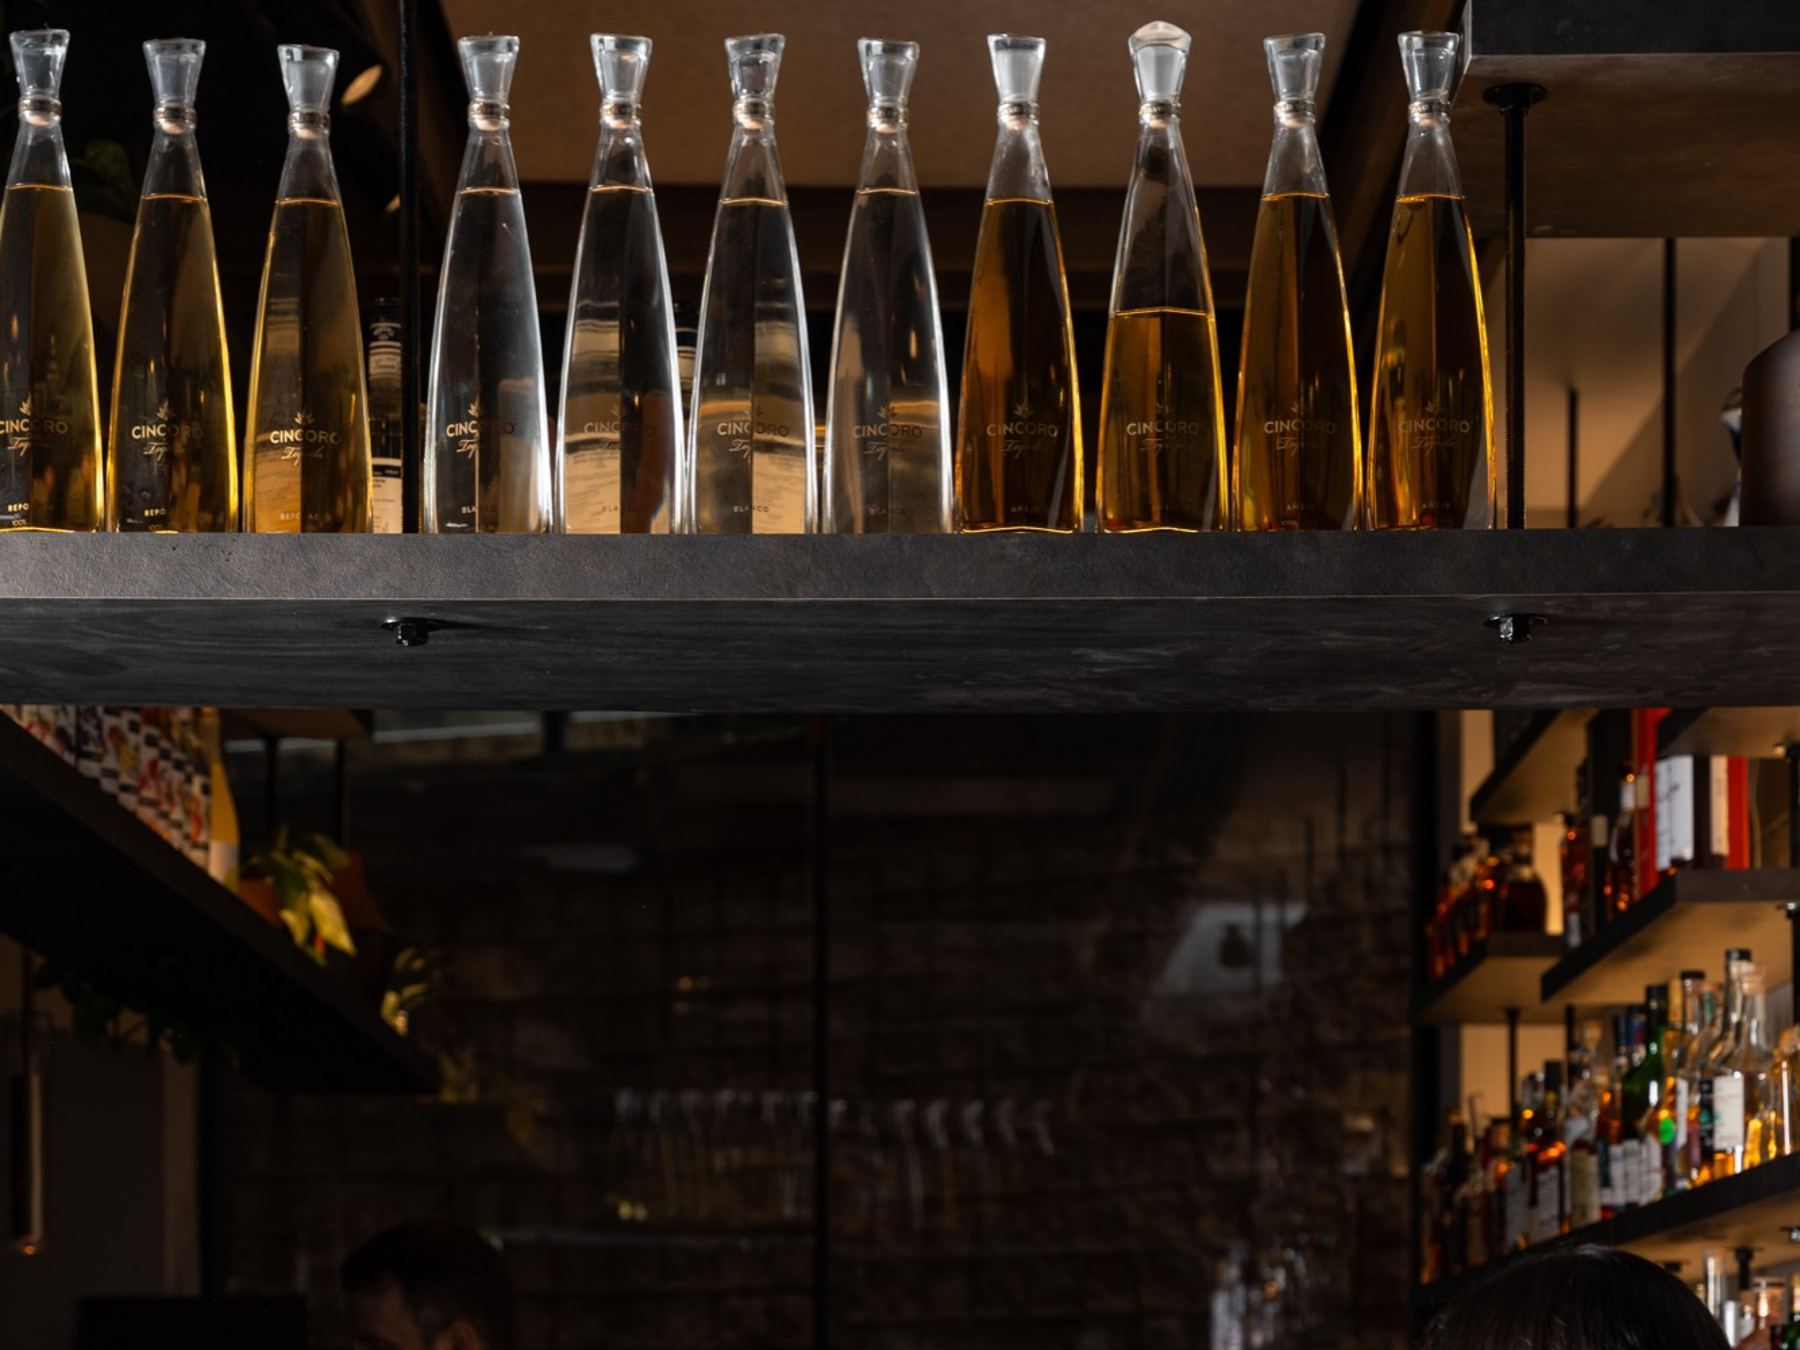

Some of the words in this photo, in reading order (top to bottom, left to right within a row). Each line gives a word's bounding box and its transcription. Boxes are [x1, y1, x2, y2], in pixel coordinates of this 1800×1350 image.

[716, 421, 789, 438] CINCORO
[852, 423, 924, 439] CINCORO
[986, 421, 1059, 438] CINCORO
[1126, 420, 1200, 436] CINCORO
[1263, 419, 1337, 434] CINCORO
[1398, 418, 1471, 433] CINCORO
[269, 428, 342, 445] CINCORO
